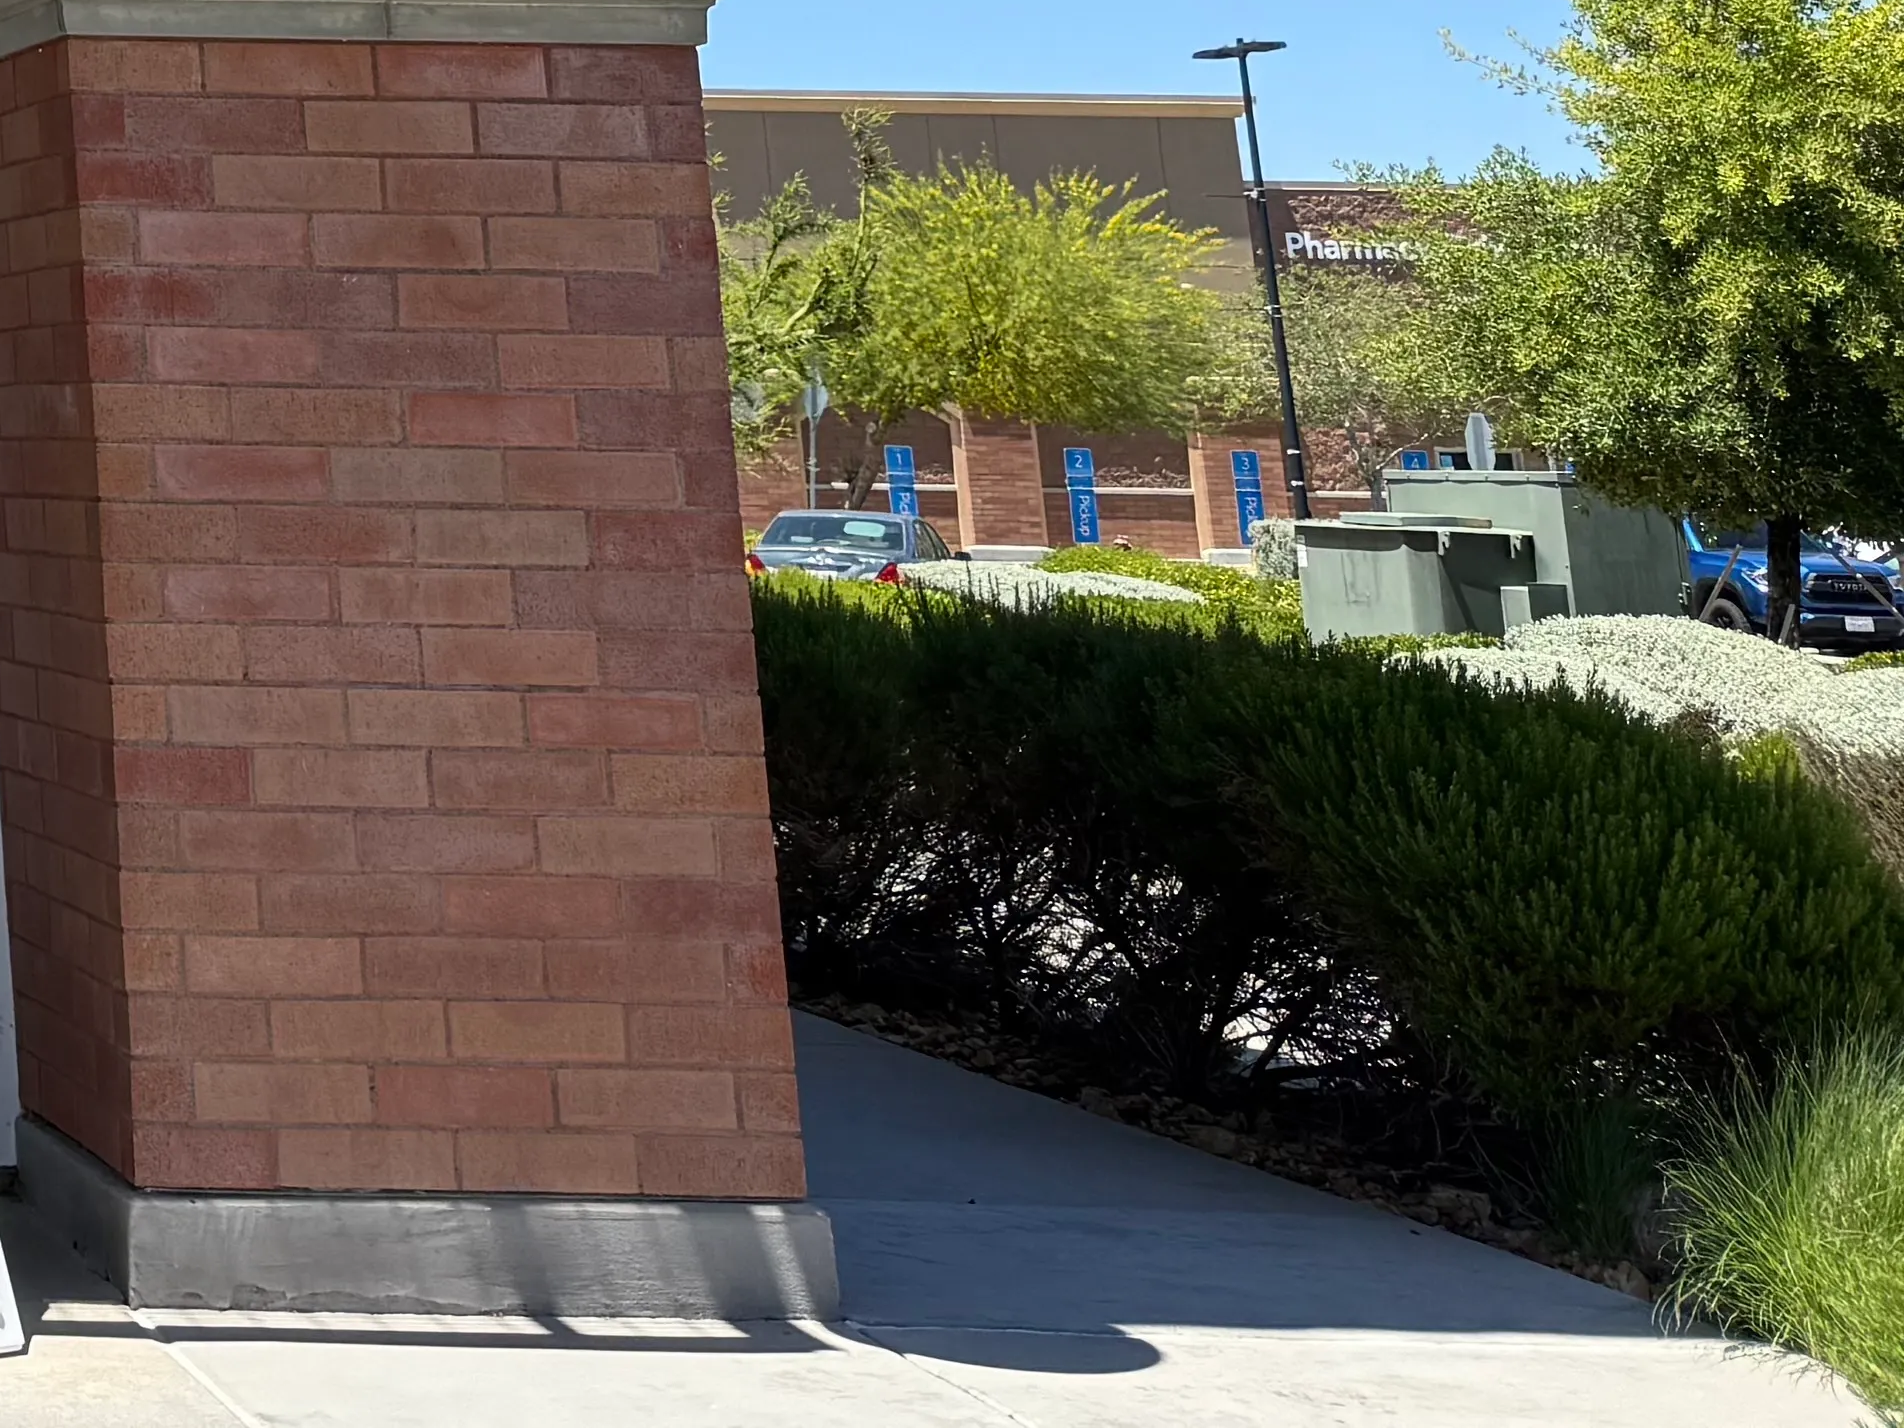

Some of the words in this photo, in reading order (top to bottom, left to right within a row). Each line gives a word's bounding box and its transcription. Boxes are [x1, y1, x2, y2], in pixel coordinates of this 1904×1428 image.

[896, 454, 902, 465] 1
[1075, 455, 1083, 468] 2
[1242, 458, 1251, 470] 3
[1077, 495, 1092, 536] Pickup
